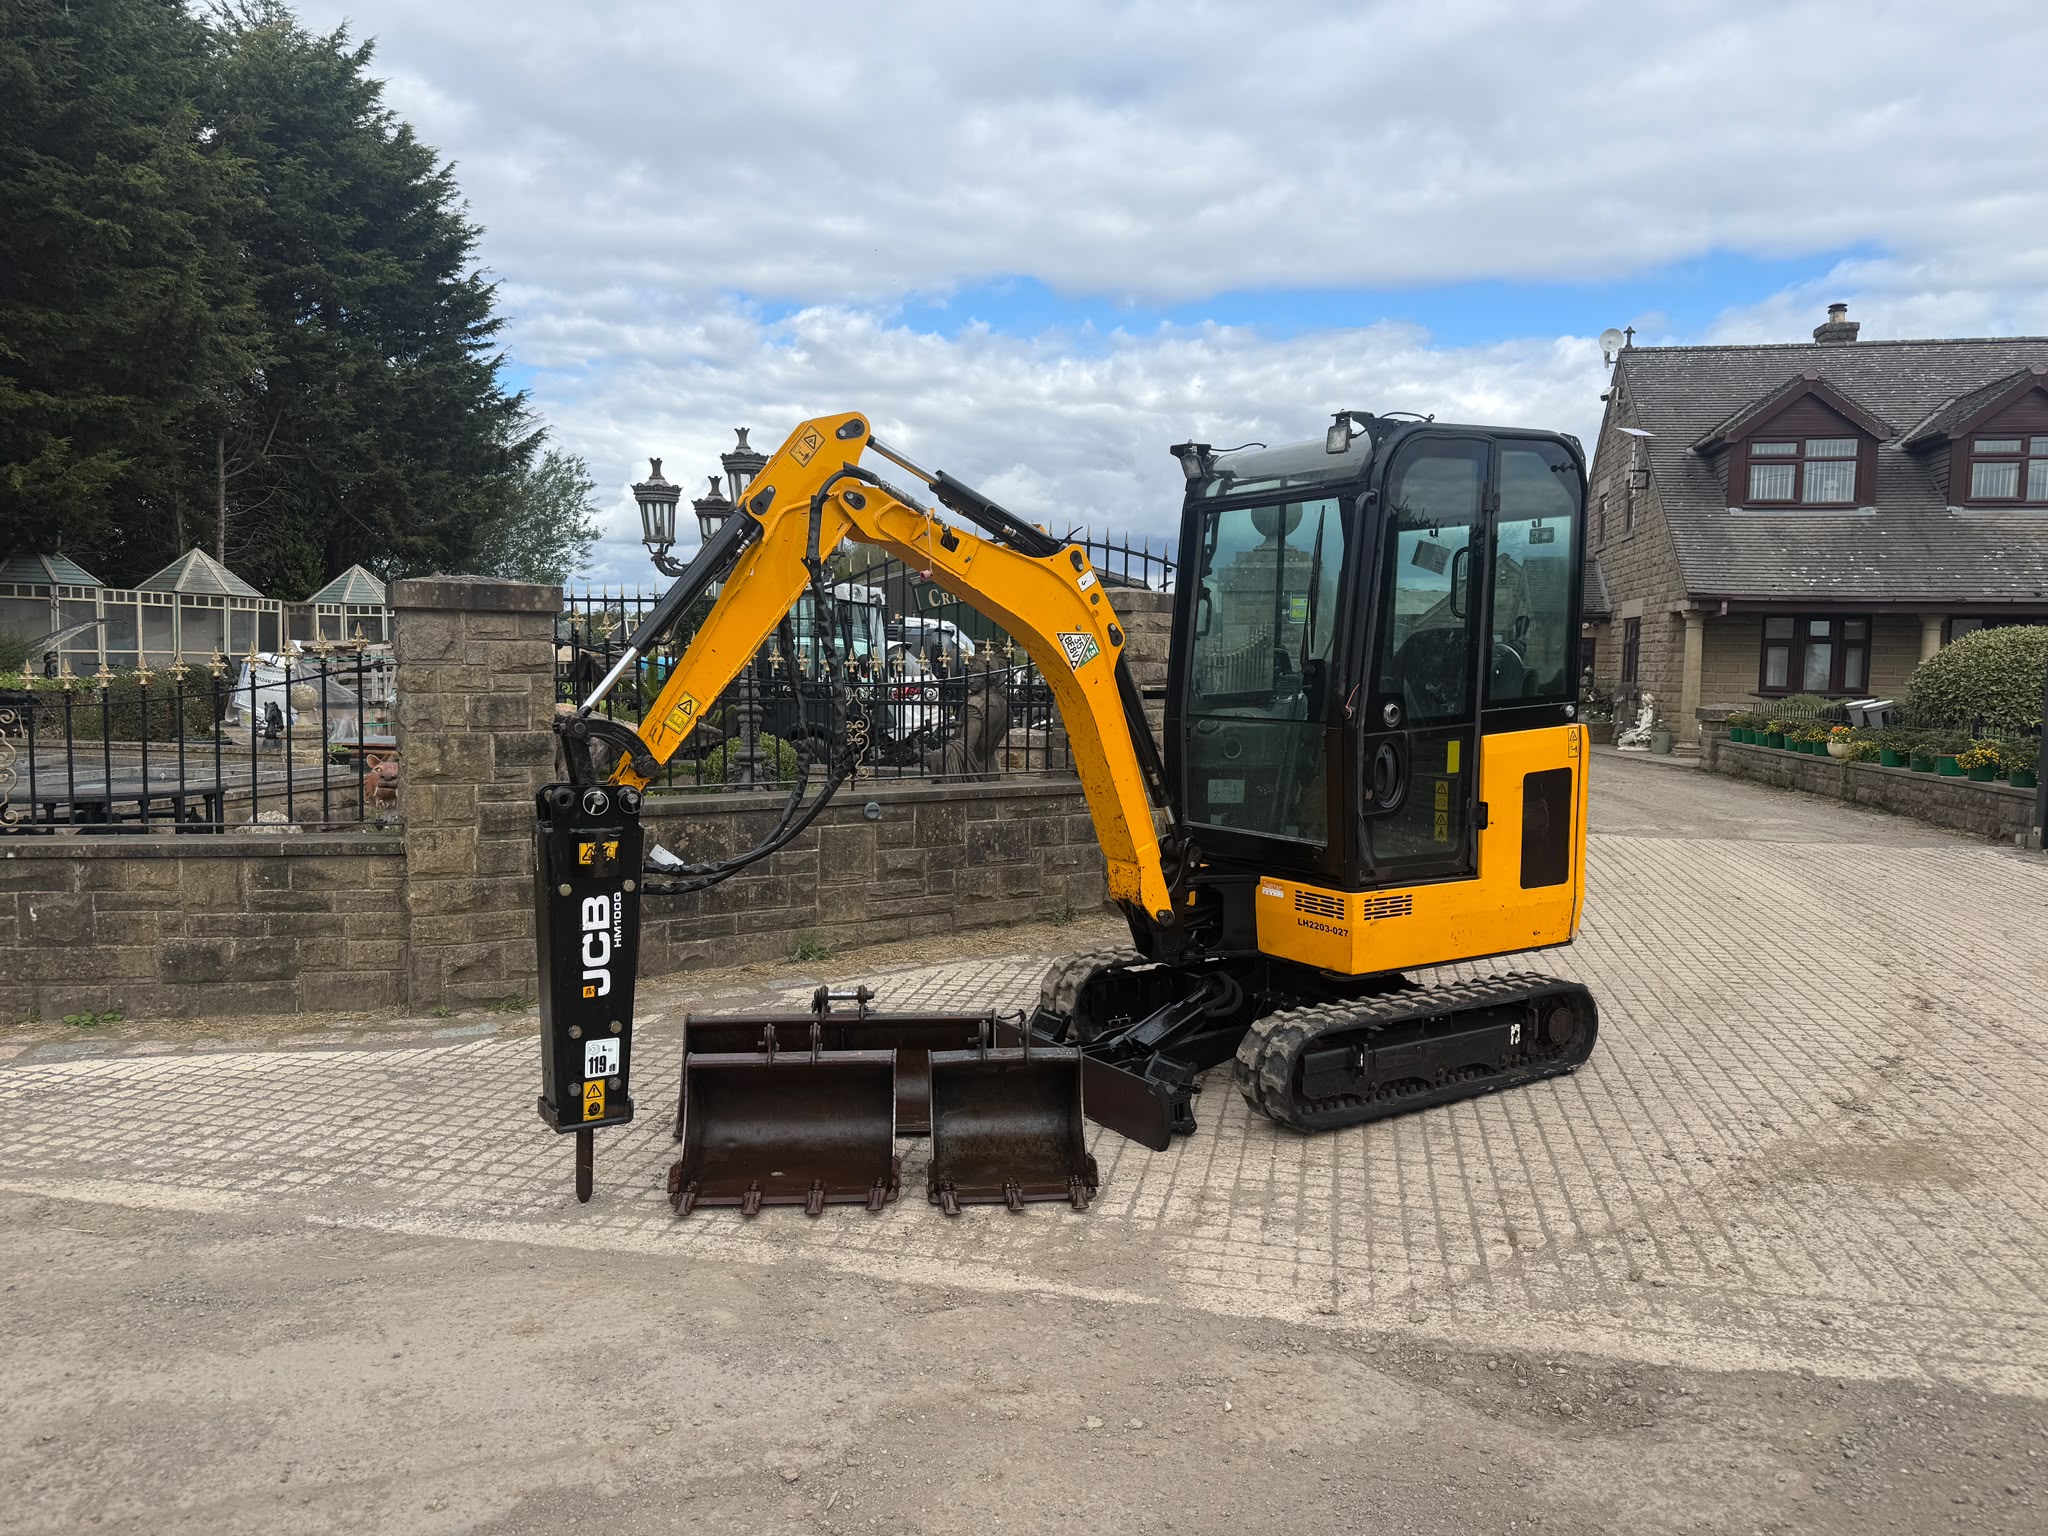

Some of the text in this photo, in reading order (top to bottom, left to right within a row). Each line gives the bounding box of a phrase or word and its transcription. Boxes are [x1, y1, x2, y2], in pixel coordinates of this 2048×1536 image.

[928, 589, 963, 607] CRI
[613, 891, 622, 948] HM100Q
[1297, 918, 1349, 937] LH2203-027
[582, 895, 611, 997] JCB
[589, 1055, 606, 1074] 119
